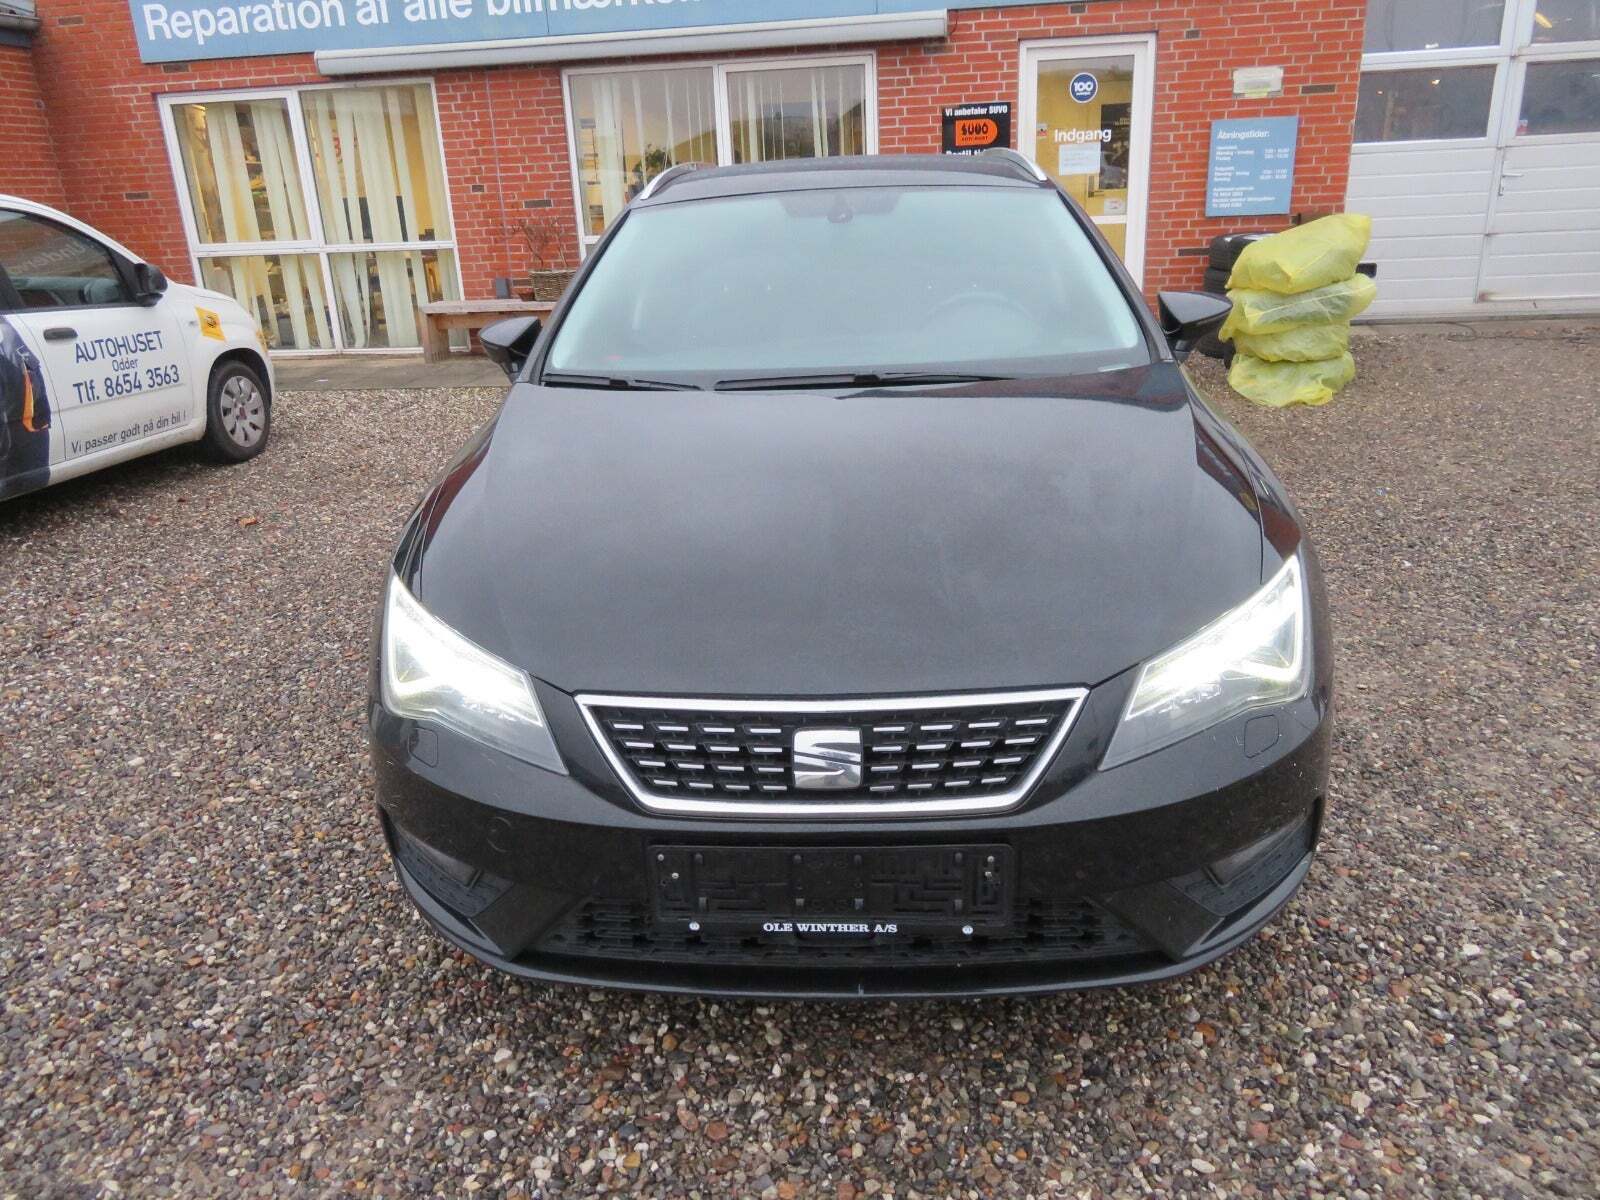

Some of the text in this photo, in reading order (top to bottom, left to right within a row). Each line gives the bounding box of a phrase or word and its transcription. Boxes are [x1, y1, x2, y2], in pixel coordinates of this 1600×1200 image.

[143, 0, 346, 45] Reparation
[1074, 81, 1094, 92] 100
[1054, 128, 1112, 143] Indgang
[75, 330, 163, 363] AUTOHUSET
[112, 357, 138, 372] Odder
[73, 364, 180, 404] Tlf. 8654 3563
[71, 441, 82, 454] Vi
[85, 433, 117, 452] passer
[120, 423, 141, 442] godt
[143, 418, 154, 436] på
[156, 416, 169, 429] din
[171, 412, 181, 425] bil
[763, 922, 898, 933] OLE WINTHER A/S
